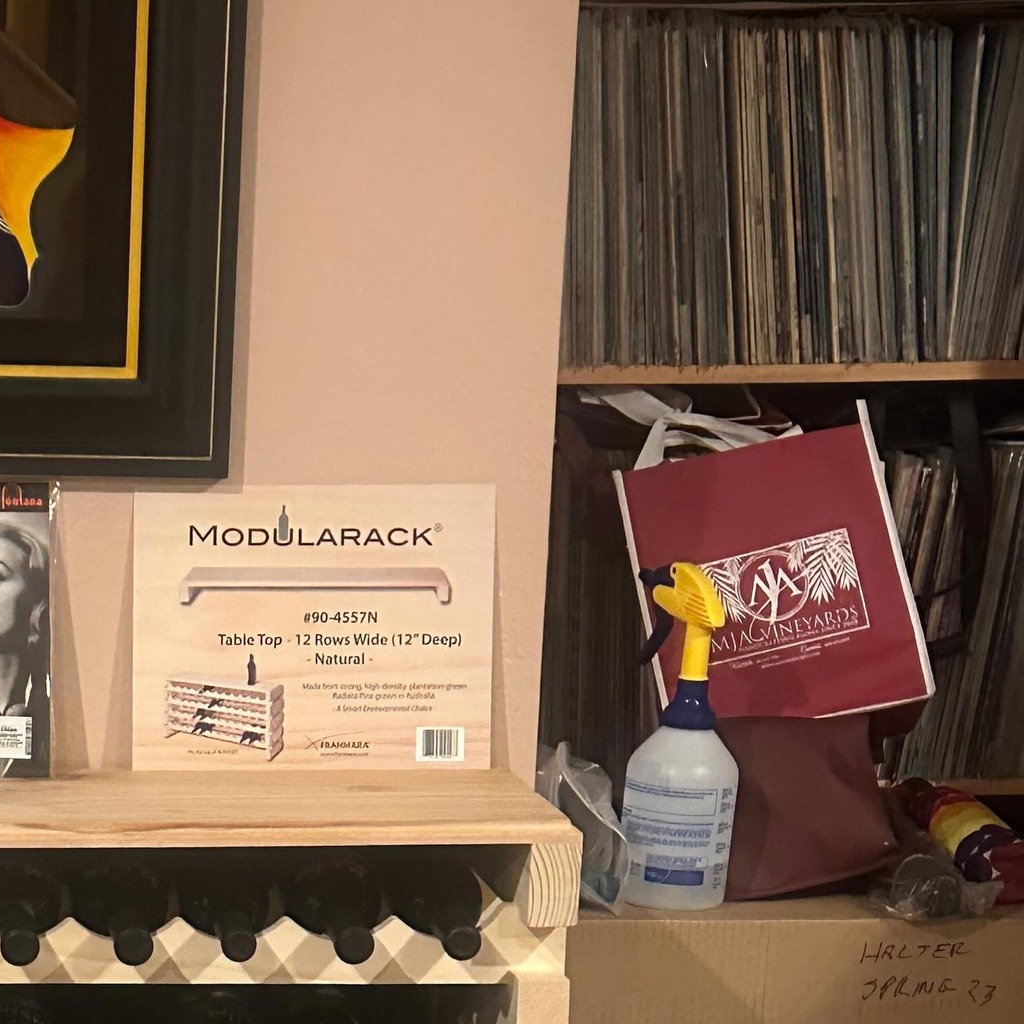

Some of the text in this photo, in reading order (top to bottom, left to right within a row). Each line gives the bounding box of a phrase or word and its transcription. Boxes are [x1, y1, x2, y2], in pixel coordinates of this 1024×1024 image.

[303, 611, 378, 624] #90-4557N
[218, 633, 255, 646] Table
[258, 633, 283, 648] Top
[295, 634, 311, 645] 12
[315, 633, 351, 646] Rows
[353, 633, 388, 646] Wide
[421, 633, 462, 648] Deep)
[315, 653, 365, 665] Natural
